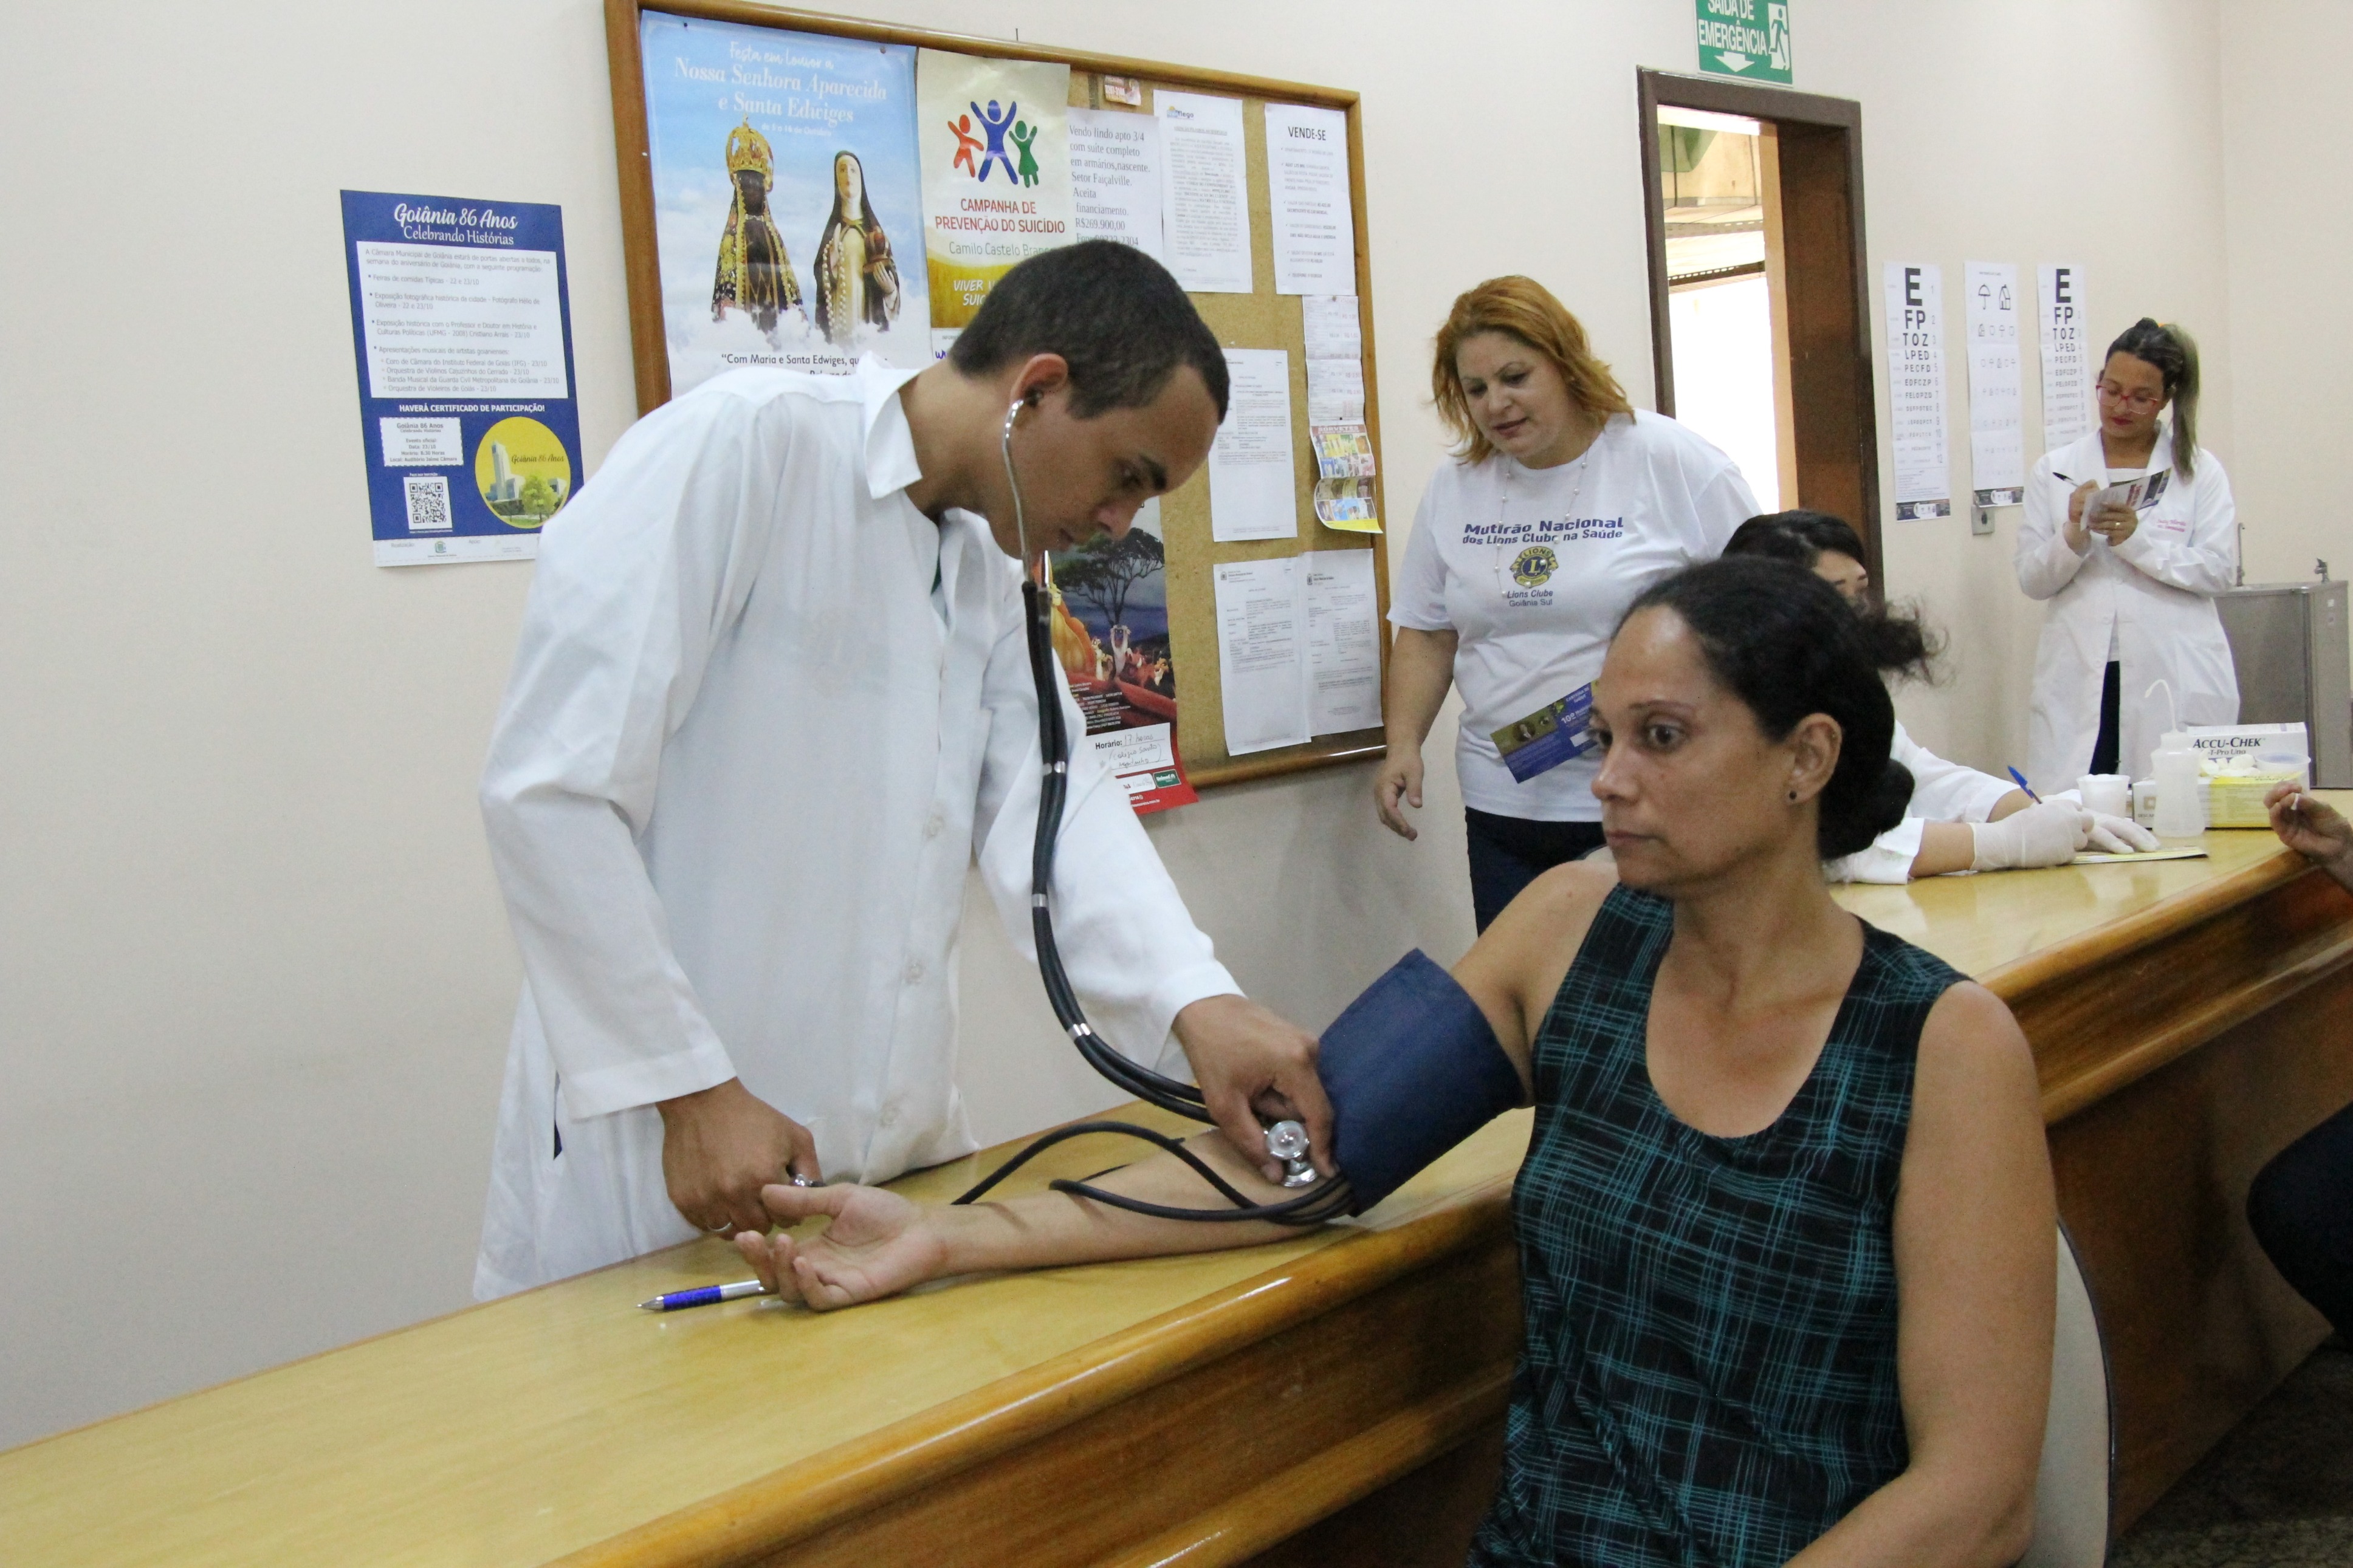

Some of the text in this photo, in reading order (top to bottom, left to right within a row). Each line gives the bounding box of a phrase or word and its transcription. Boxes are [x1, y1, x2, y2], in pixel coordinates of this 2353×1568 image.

[1740, 0, 1754, 21] DE
[1699, 19, 1767, 56] EMERGÊNCIA
[730, 41, 761, 62] Festa
[764, 53, 783, 65] em
[675, 57, 887, 100] Nossa Senhora Aparecida
[719, 92, 853, 128] e Santa Edwiges
[1070, 125, 1144, 142] Vendo lindo apto 3/4
[1288, 126, 1326, 140] VENDE-SE
[1088, 143, 1104, 153] suíte
[1106, 146, 1139, 157] completo
[1084, 159, 1150, 173] armários,nascente.
[1072, 171, 1132, 187] Setor Faiçalville.
[1073, 187, 1096, 197] Aceita
[961, 199, 1036, 214] CAMPANHA DE
[1077, 203, 1128, 216] financiamento.
[394, 203, 518, 229] Goiânia 86 Anos
[935, 216, 1065, 234] PREVENÇÃO DO SUICÍDIO
[1076, 217, 1125, 230] R$269.900,00
[404, 225, 514, 245] Celebrando Histórias
[949, 242, 1050, 256] Camilo Castelo Bran
[953, 280, 983, 292] VIVER
[1905, 268, 1922, 306] E
[2056, 269, 2071, 303] E
[1931, 315, 1936, 325] 2
[751, 354, 776, 364] Maria
[787, 355, 810, 364] Santa
[813, 355, 847, 367] Edwiges,
[399, 403, 429, 412] HAVERÁ
[492, 403, 545, 413] PARTICIPAÇÃO!
[512, 454, 537, 464] Goiânia
[538, 454, 546, 462] 86
[1465, 517, 1624, 535] Mutirão Nacional
[1463, 535, 1483, 545] dos
[1486, 534, 1518, 544] Lions
[1564, 533, 1578, 541] na
[1582, 529, 1623, 540] Saúde
[1523, 548, 1551, 557] LIONS
[1528, 560, 1540, 573] L
[1507, 589, 1528, 598] Lions
[1095, 740, 1122, 750] Horário:
[1124, 733, 1153, 745] 17 horas
[2193, 737, 2261, 749] ACCU-CHEK
